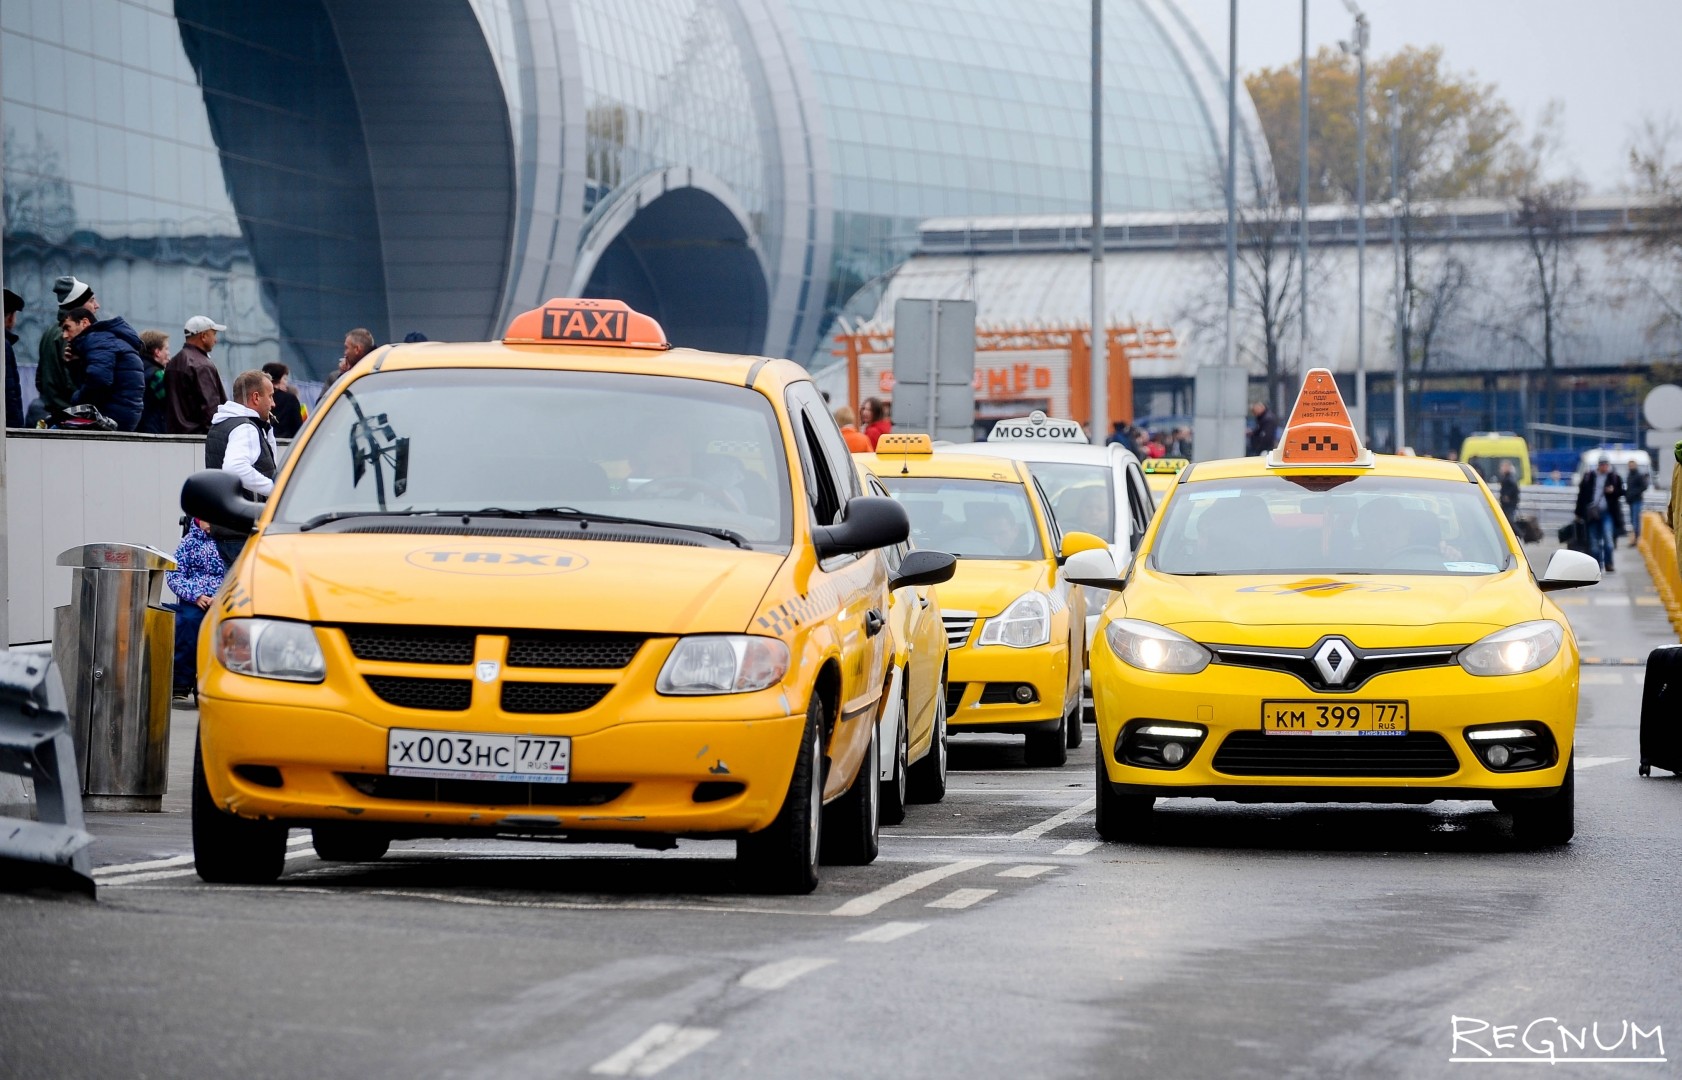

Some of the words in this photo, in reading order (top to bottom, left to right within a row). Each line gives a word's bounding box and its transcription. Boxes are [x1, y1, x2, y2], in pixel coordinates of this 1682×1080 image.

[547, 310, 625, 339] TAXI
[995, 427, 1077, 438] MOSCOW
[425, 551, 573, 568] TAXI
[1316, 706, 1361, 728] 399
[1375, 705, 1399, 722] 77
[518, 740, 561, 762] 777
[527, 762, 549, 770] RUS
